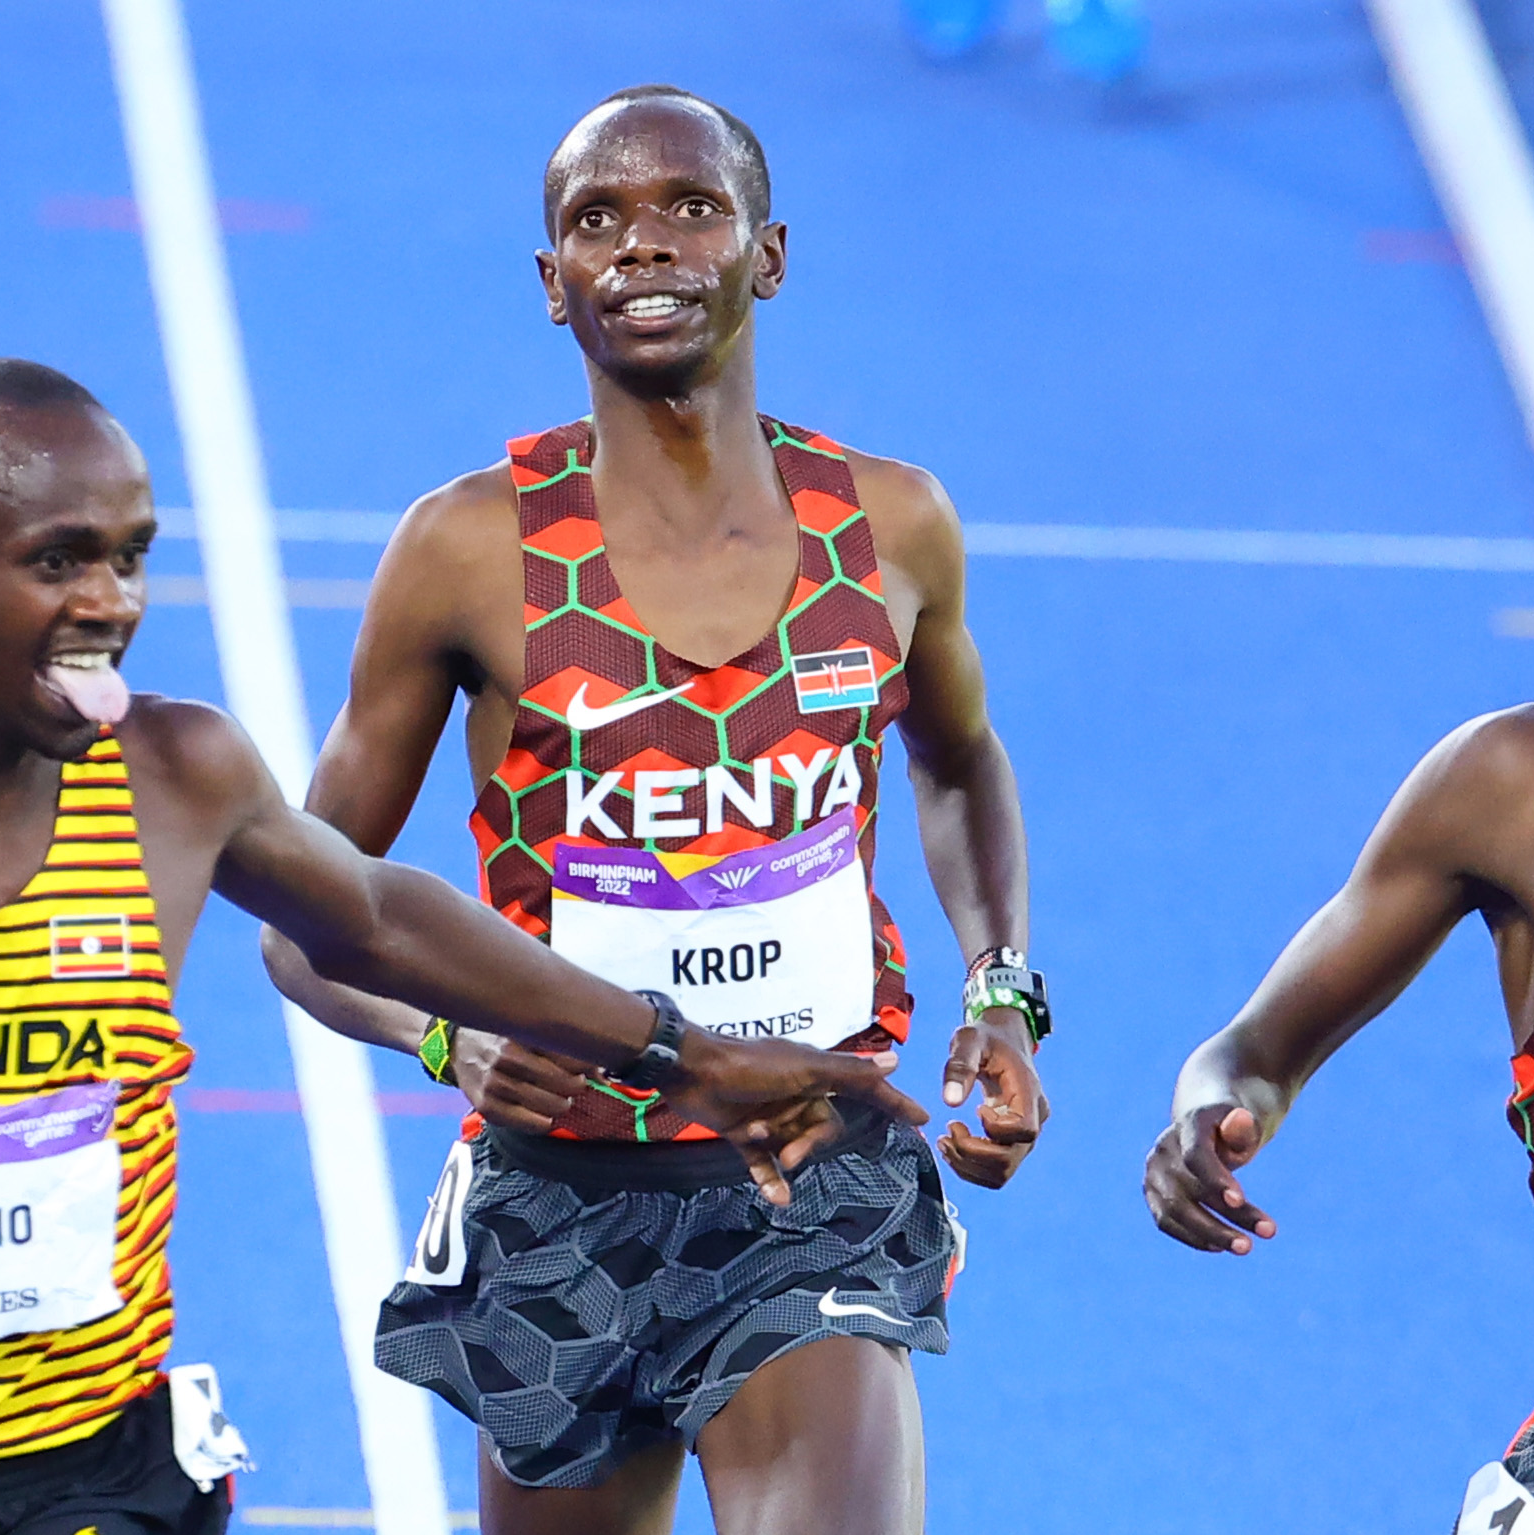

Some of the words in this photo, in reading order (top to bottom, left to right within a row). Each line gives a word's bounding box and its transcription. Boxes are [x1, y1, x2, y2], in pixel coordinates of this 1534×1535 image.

[565, 744, 863, 839] KENYA
[770, 825, 850, 872] commonwealth
[796, 849, 834, 878] games
[568, 862, 657, 884] BIRMINGHAM
[595, 878, 632, 896] 2022
[672, 939, 782, 986] KROP
